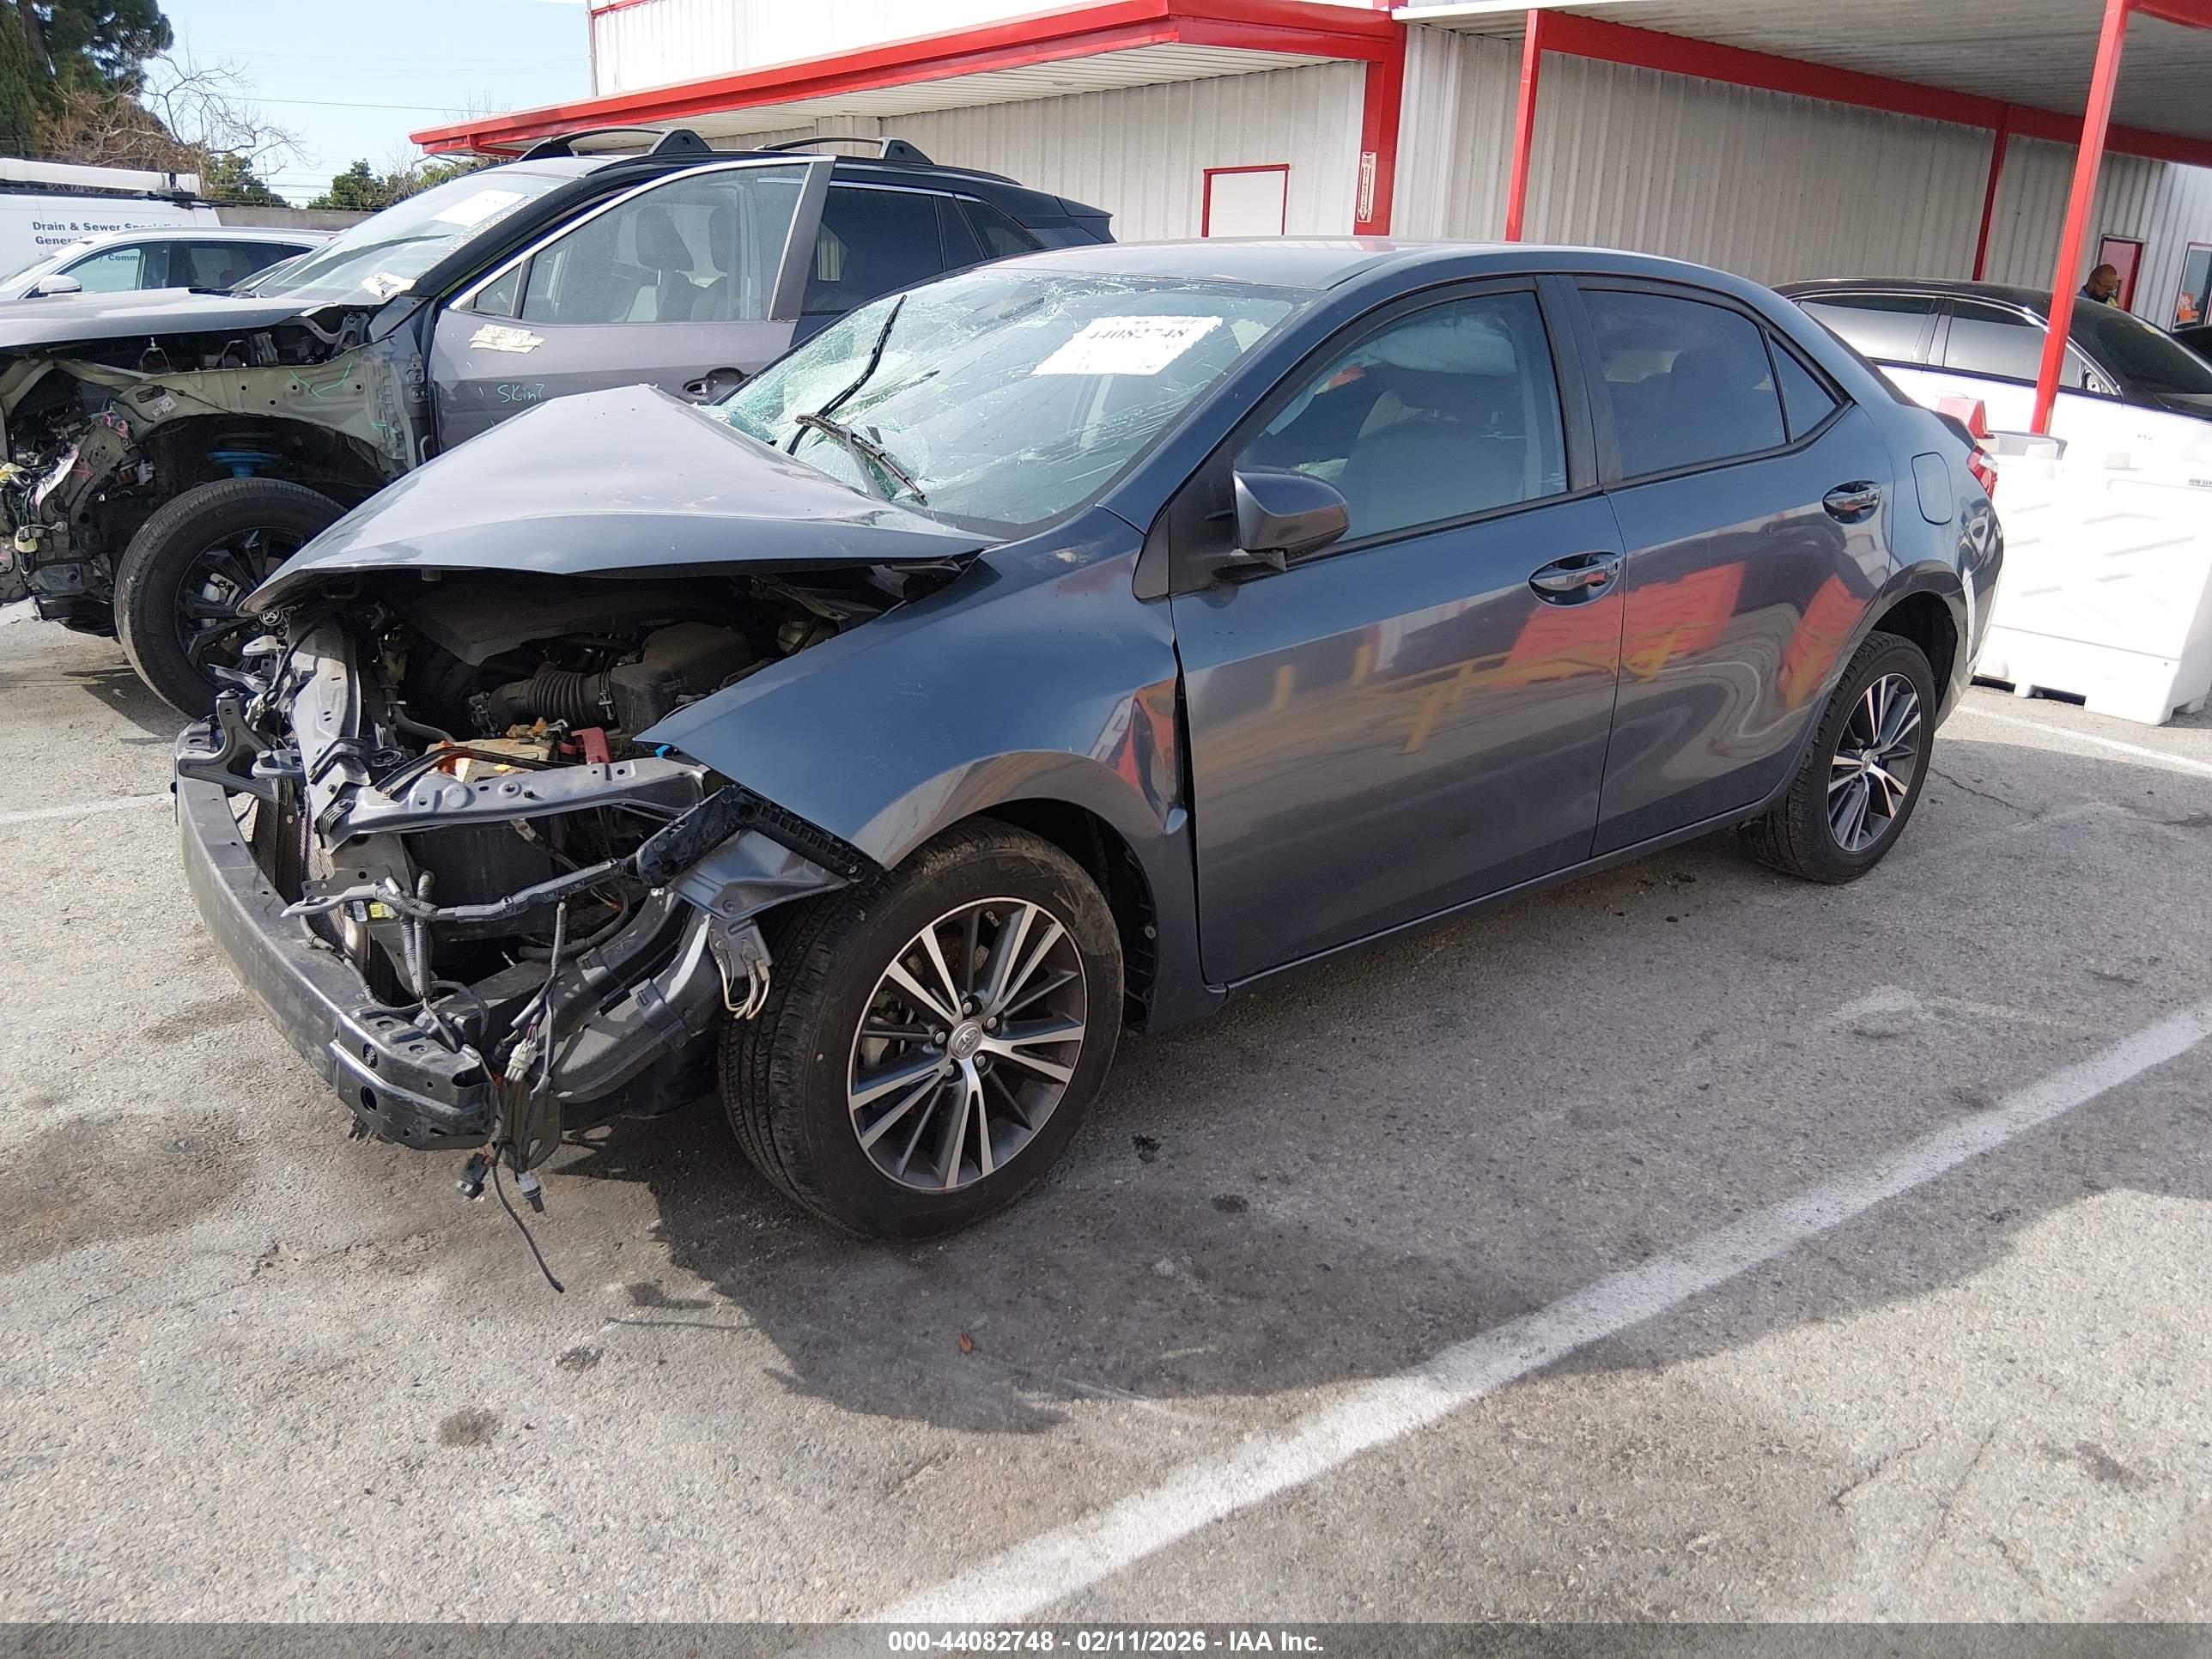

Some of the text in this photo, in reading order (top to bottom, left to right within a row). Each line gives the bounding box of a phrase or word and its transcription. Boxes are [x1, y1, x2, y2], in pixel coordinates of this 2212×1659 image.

[33, 222, 66, 231] Drain
[70, 222, 80, 231] &
[83, 222, 121, 232] Sewer
[35, 235, 82, 246] Gener
